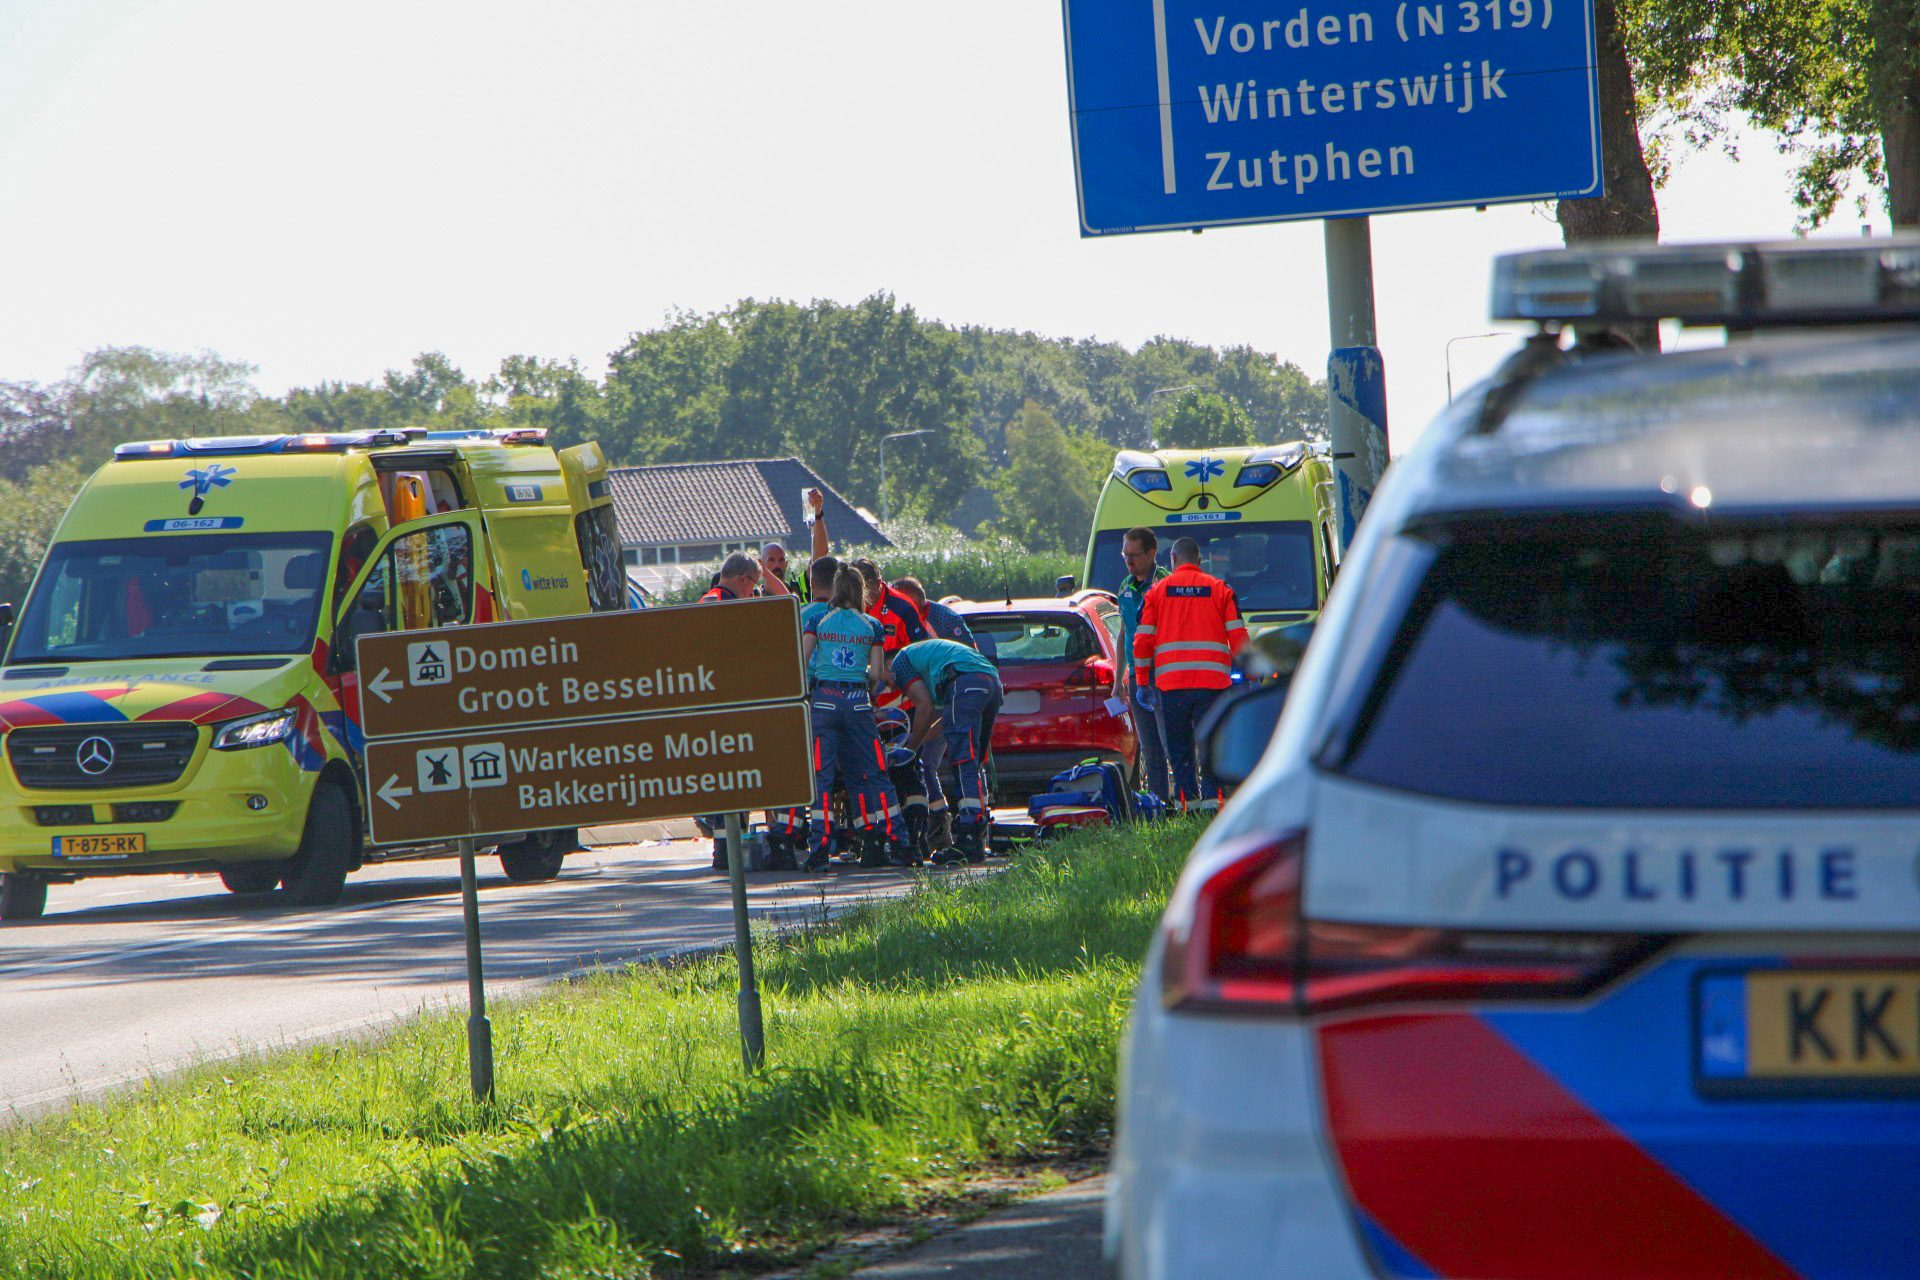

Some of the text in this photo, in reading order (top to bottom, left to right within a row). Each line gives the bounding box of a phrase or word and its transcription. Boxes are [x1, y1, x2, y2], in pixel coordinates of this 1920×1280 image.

[1194, 0, 1553, 56] Vorden (N 319)
[1197, 59, 1508, 124] Winterswijk
[1205, 142, 1415, 194] Zutphen
[172, 520, 214, 528] 06-162
[532, 574, 569, 590] witte kruis
[455, 637, 579, 673] Domein
[817, 632, 874, 646] AMBULANCE
[33, 673, 218, 691] AMBULANCE
[458, 665, 716, 713] Groot Besselink
[509, 730, 754, 774] Warkense Molen
[517, 768, 763, 810] Bakkerijmuseum
[66, 837, 137, 853] T-875-RK
[1494, 847, 1857, 901] POLITIE
[1788, 985, 1920, 1061] KK
